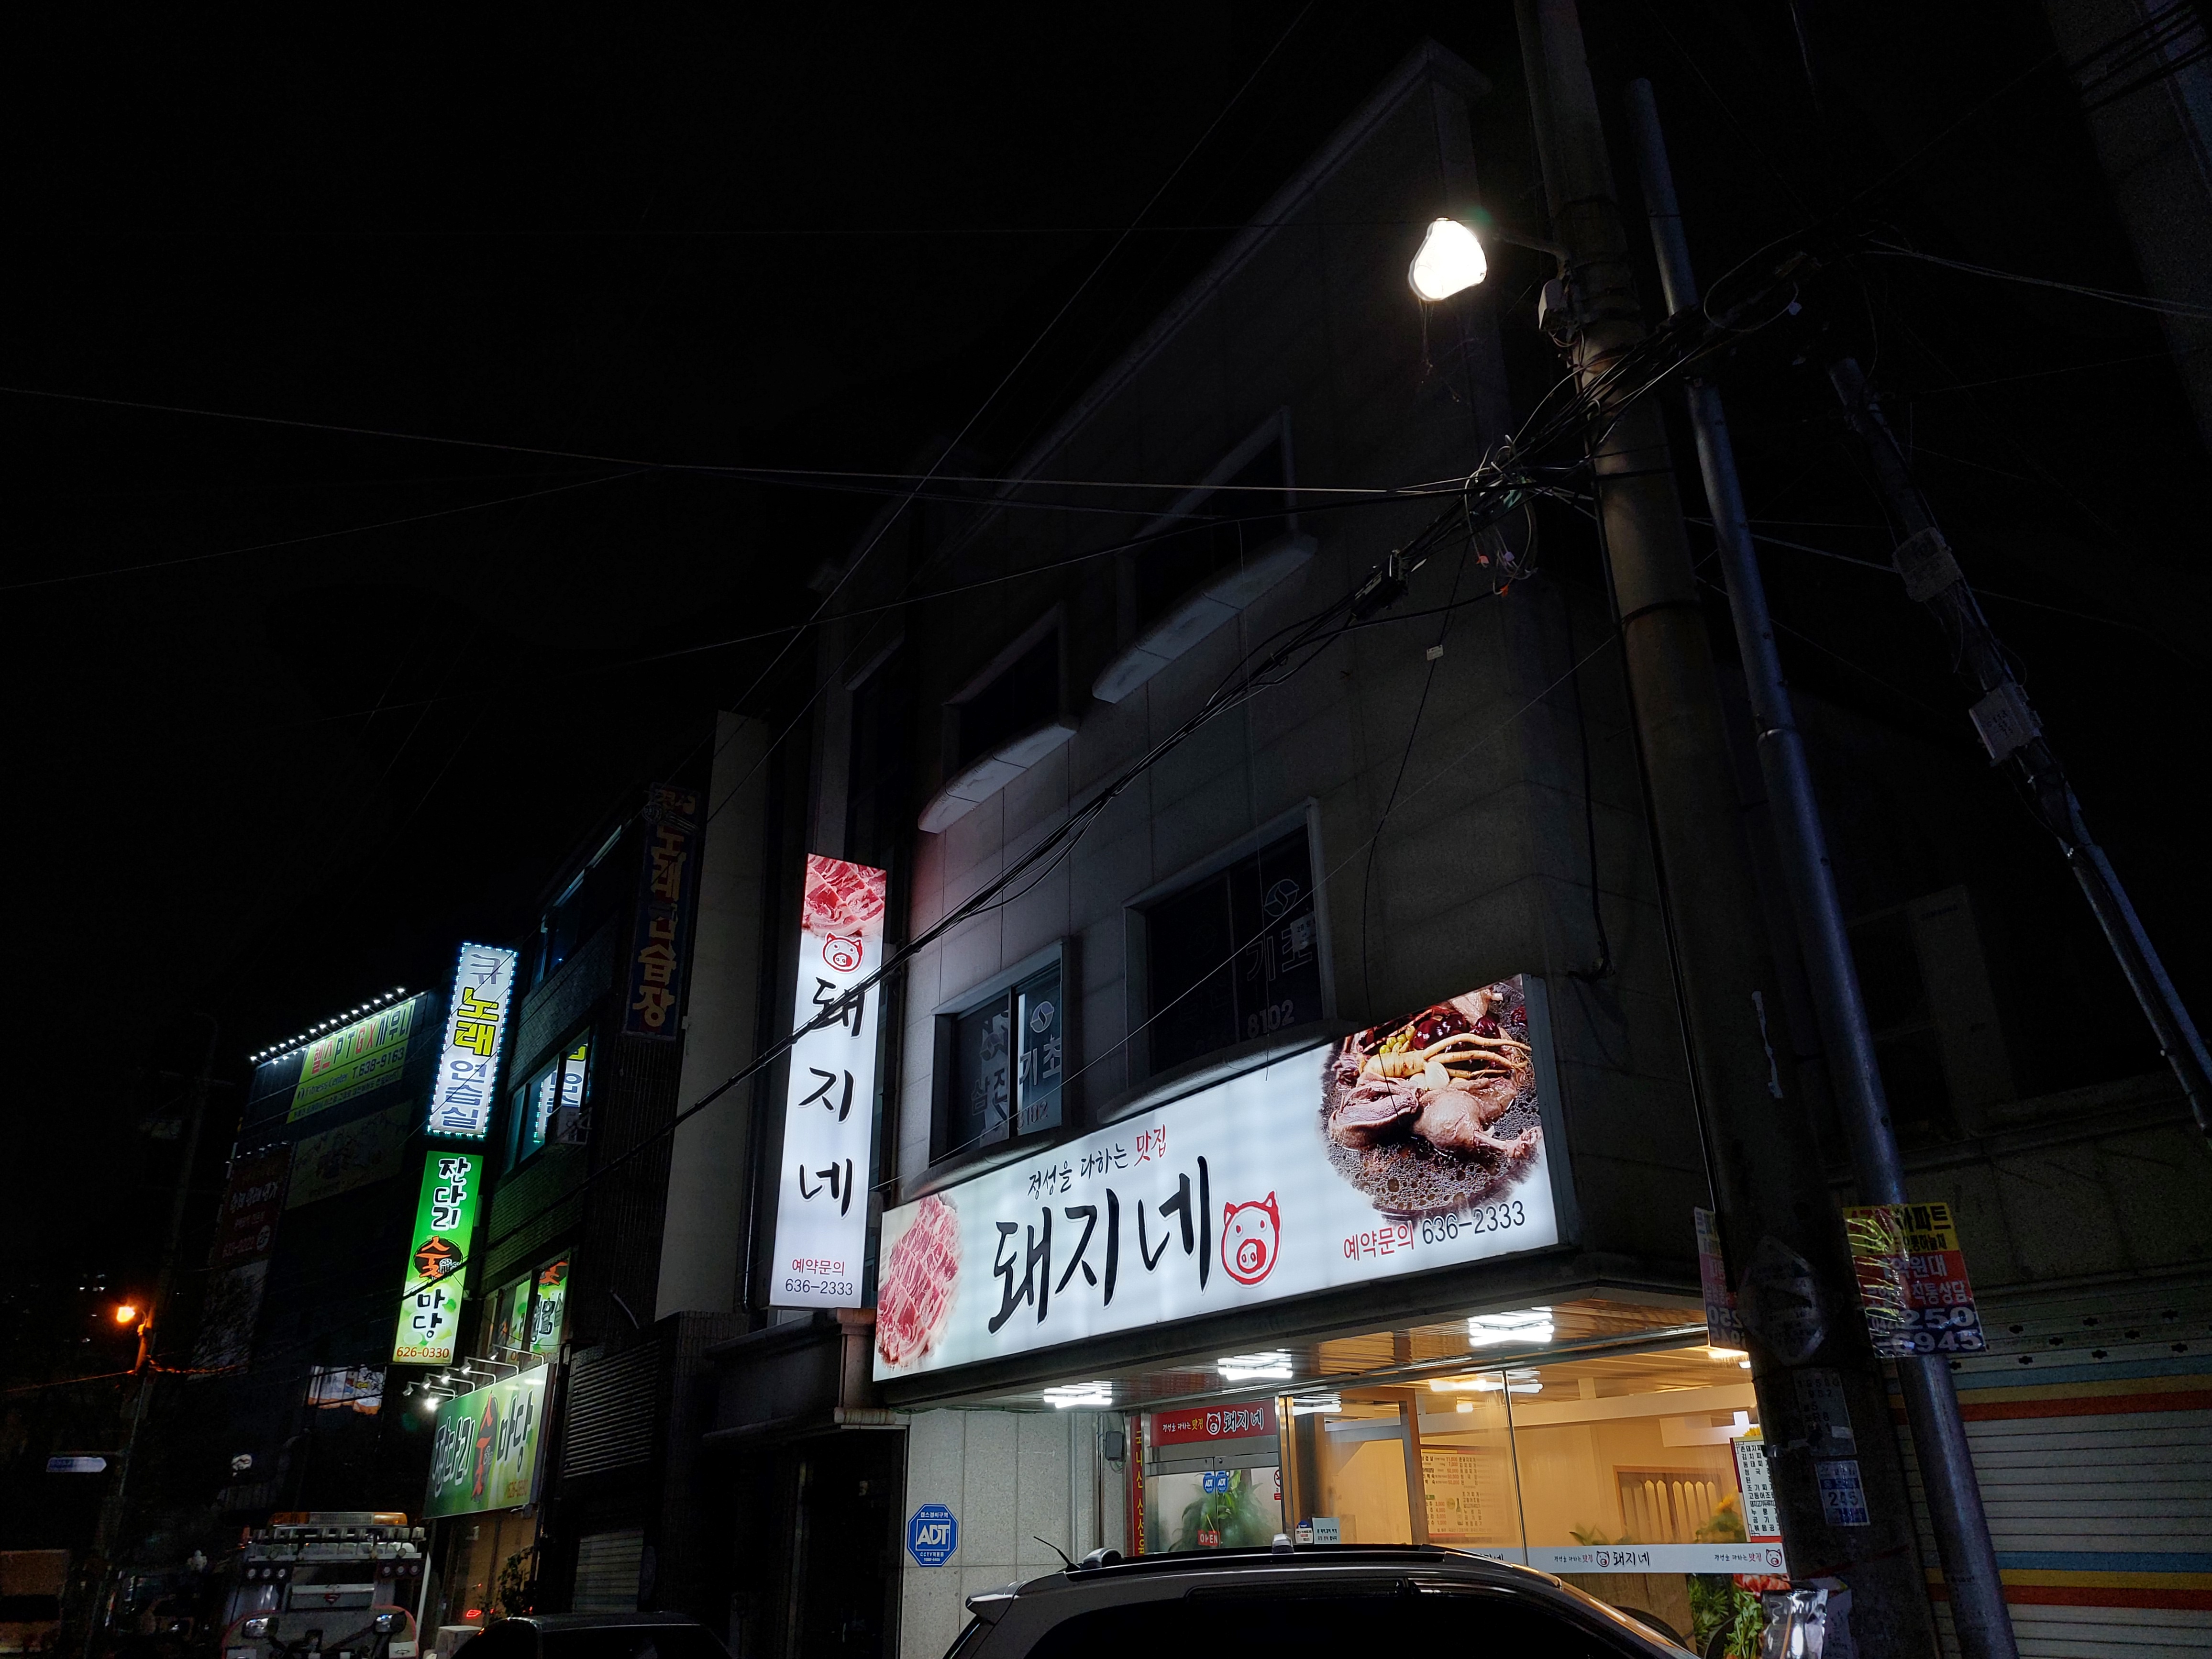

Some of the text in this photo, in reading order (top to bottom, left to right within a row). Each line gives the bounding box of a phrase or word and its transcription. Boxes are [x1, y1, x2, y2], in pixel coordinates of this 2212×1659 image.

[470, 953, 504, 984] 큐
[1247, 999, 1294, 1039] 8102
[1019, 1034, 1061, 1086] 기초
[798, 977, 865, 1218] 돼지네
[1027, 1124, 1166, 1202] 정성을 다하는 맛집
[431, 1157, 471, 1230] 잔다리
[988, 1155, 1211, 1335] 돼지네
[1344, 1200, 1526, 1260] 예약문의 636-2333
[792, 1258, 845, 1276] 예약문의
[785, 1278, 853, 1296] 636-2333
[413, 1289, 442, 1338] 마당
[397, 1345, 450, 1360] 626-0330
[1192, 1418, 1203, 1430] 맛집
[1223, 1407, 1264, 1433] 돼지네
[432, 1416, 475, 1497] 잔다리
[498, 1389, 533, 1473] 마당
[1205, 1478, 1226, 1487] ADT ADT
[917, 1524, 949, 1545] ADT
[1199, 1533, 1218, 1544] OPEN
[1613, 1551, 1650, 1567] 돼지네
[1748, 1552, 1761, 1562] 맛집
